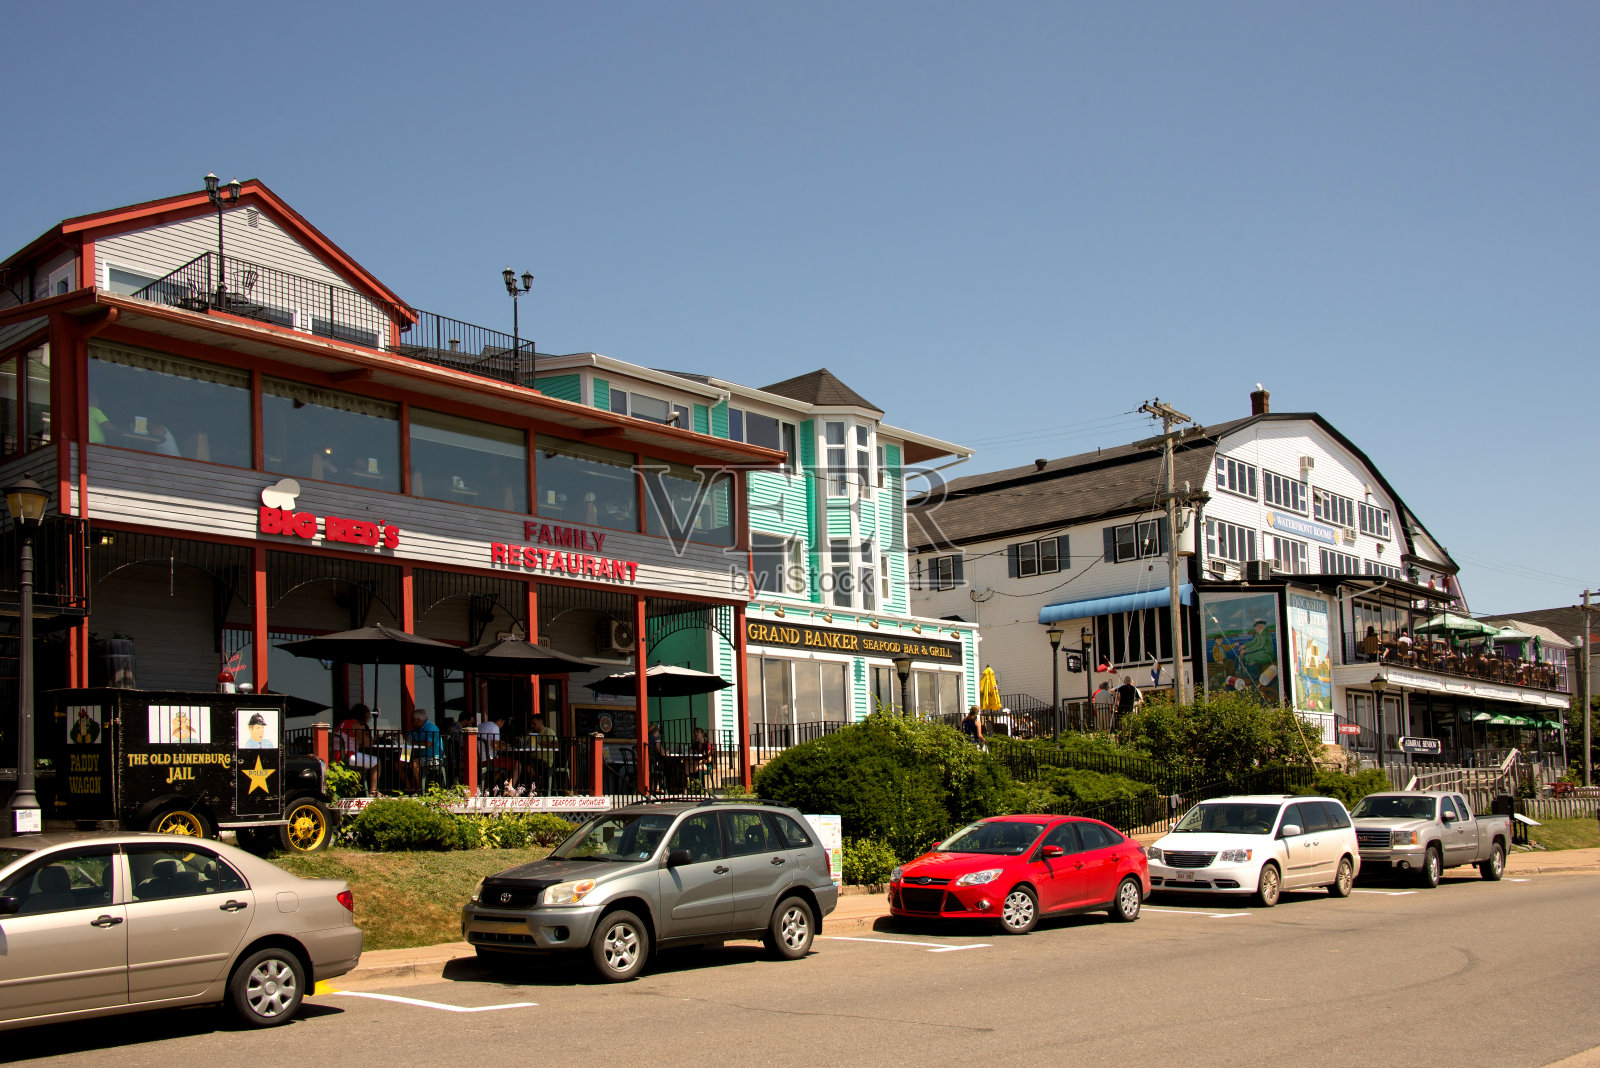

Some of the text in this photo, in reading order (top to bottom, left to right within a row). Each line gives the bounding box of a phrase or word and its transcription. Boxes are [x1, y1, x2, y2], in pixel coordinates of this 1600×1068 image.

[260, 506, 399, 549] BIG RED'S
[524, 520, 606, 552] FAMILY
[1276, 515, 1332, 540] WATERFRONT ROOMS
[491, 542, 639, 581] RESTAURANT
[1291, 595, 1326, 613] DOCKSIDE
[747, 623, 952, 658] GRAND BANKER SEAFOOD BAR & GRILL
[70, 754, 99, 772] PADDY
[127, 753, 231, 769] THE OLD LUNENBURG
[166, 766, 195, 784] JAIL
[248, 769, 268, 777] POLICE
[69, 776, 101, 794] WAGON
[489, 799, 508, 808] FISH
[551, 799, 606, 808] SEAFOOD CHOWDER
